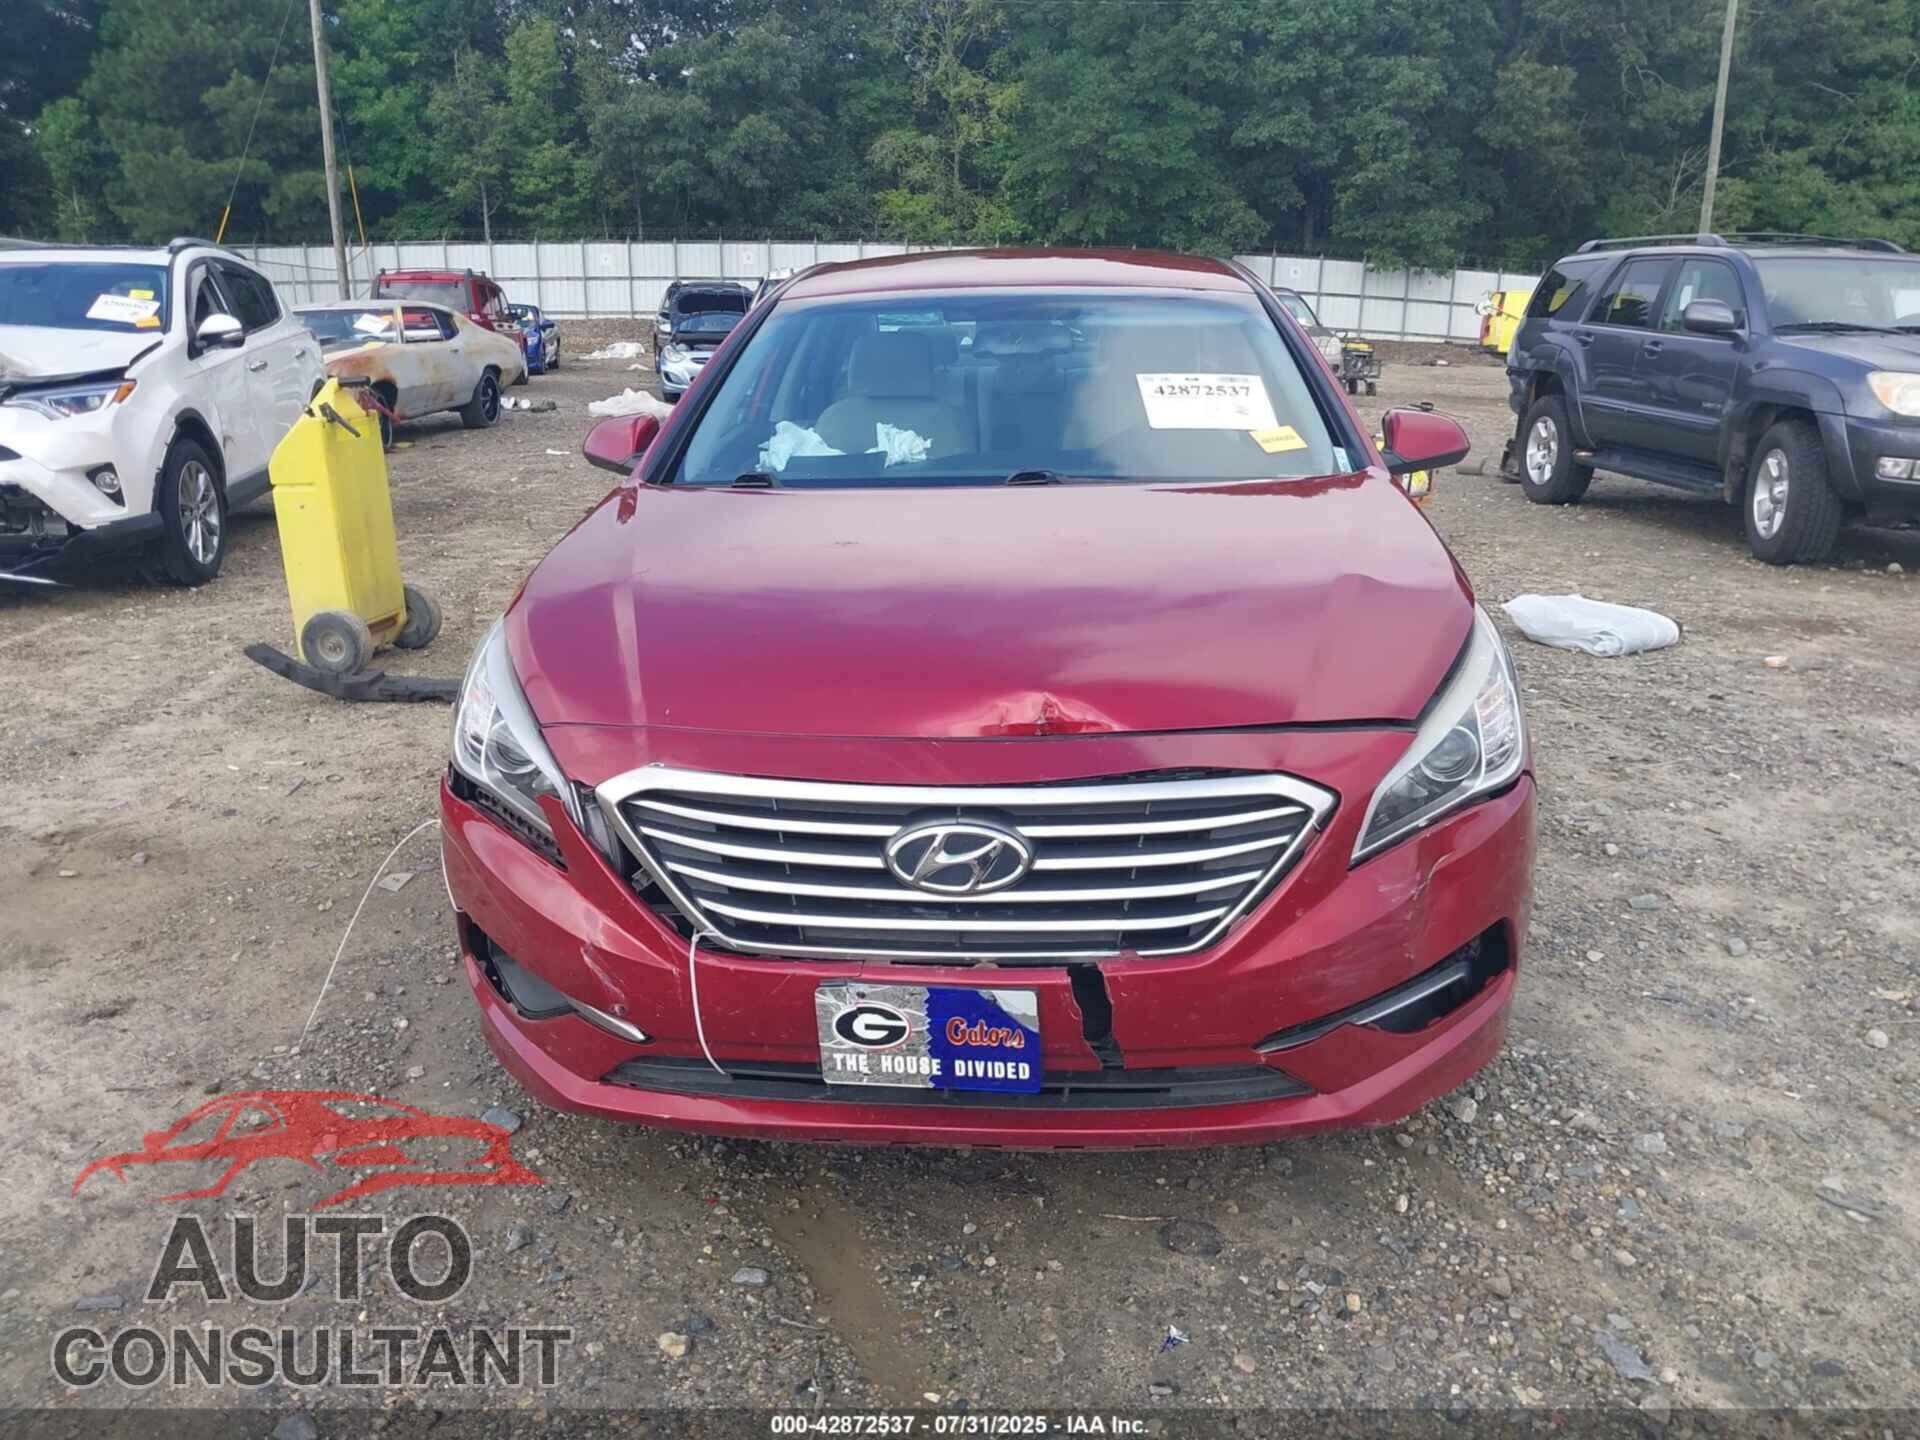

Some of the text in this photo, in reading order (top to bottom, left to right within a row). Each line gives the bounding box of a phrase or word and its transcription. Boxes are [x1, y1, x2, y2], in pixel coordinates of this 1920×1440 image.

[1154, 384, 1250, 397] 42872537
[836, 1006, 907, 1040] G
[946, 1015, 1025, 1048] Gators
[833, 1053, 1030, 1080] THE HOUSE DIVIDED
